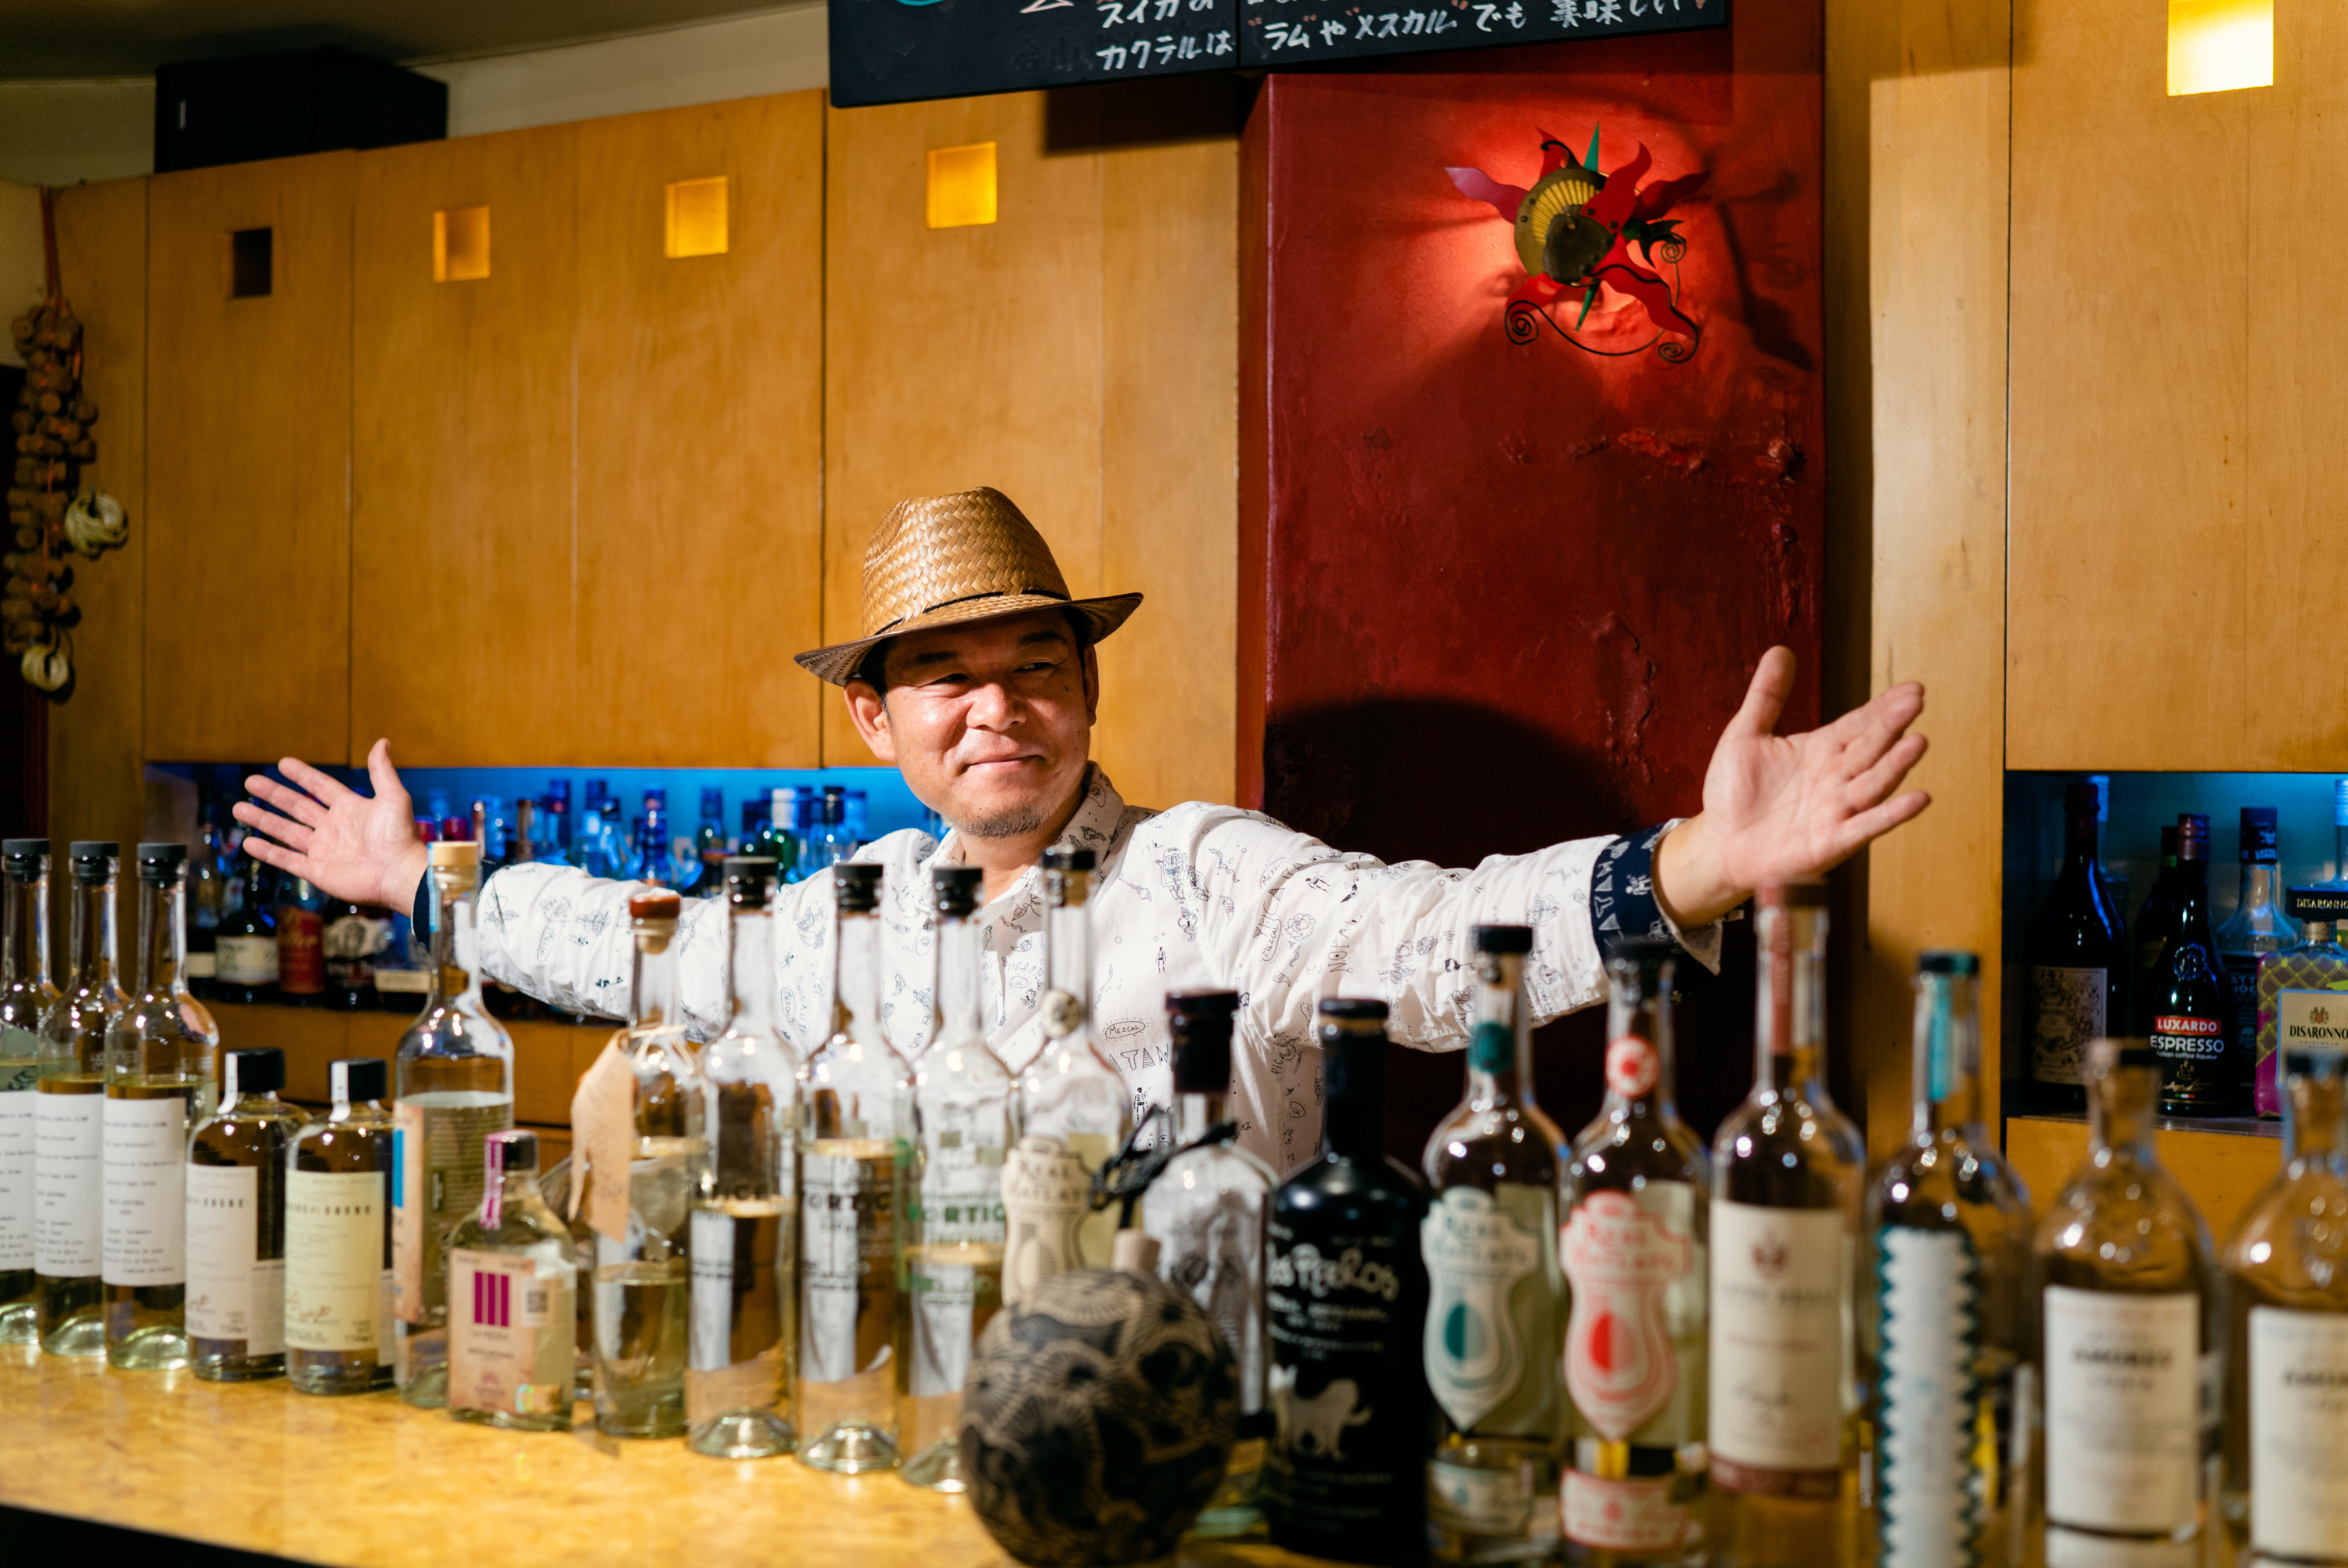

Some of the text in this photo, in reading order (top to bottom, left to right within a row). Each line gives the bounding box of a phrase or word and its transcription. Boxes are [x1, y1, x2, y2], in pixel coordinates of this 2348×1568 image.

[1095, 29, 1234, 71] カクテルは
[1262, 925, 1280, 958] MEZCAL
[1109, 1025, 1140, 1034] MEZCAL
[2157, 1018, 2217, 1033] LUXARDO
[2289, 1025, 2348, 1040] DISARONNO
[2150, 1034, 2224, 1053] ESPRESSO
